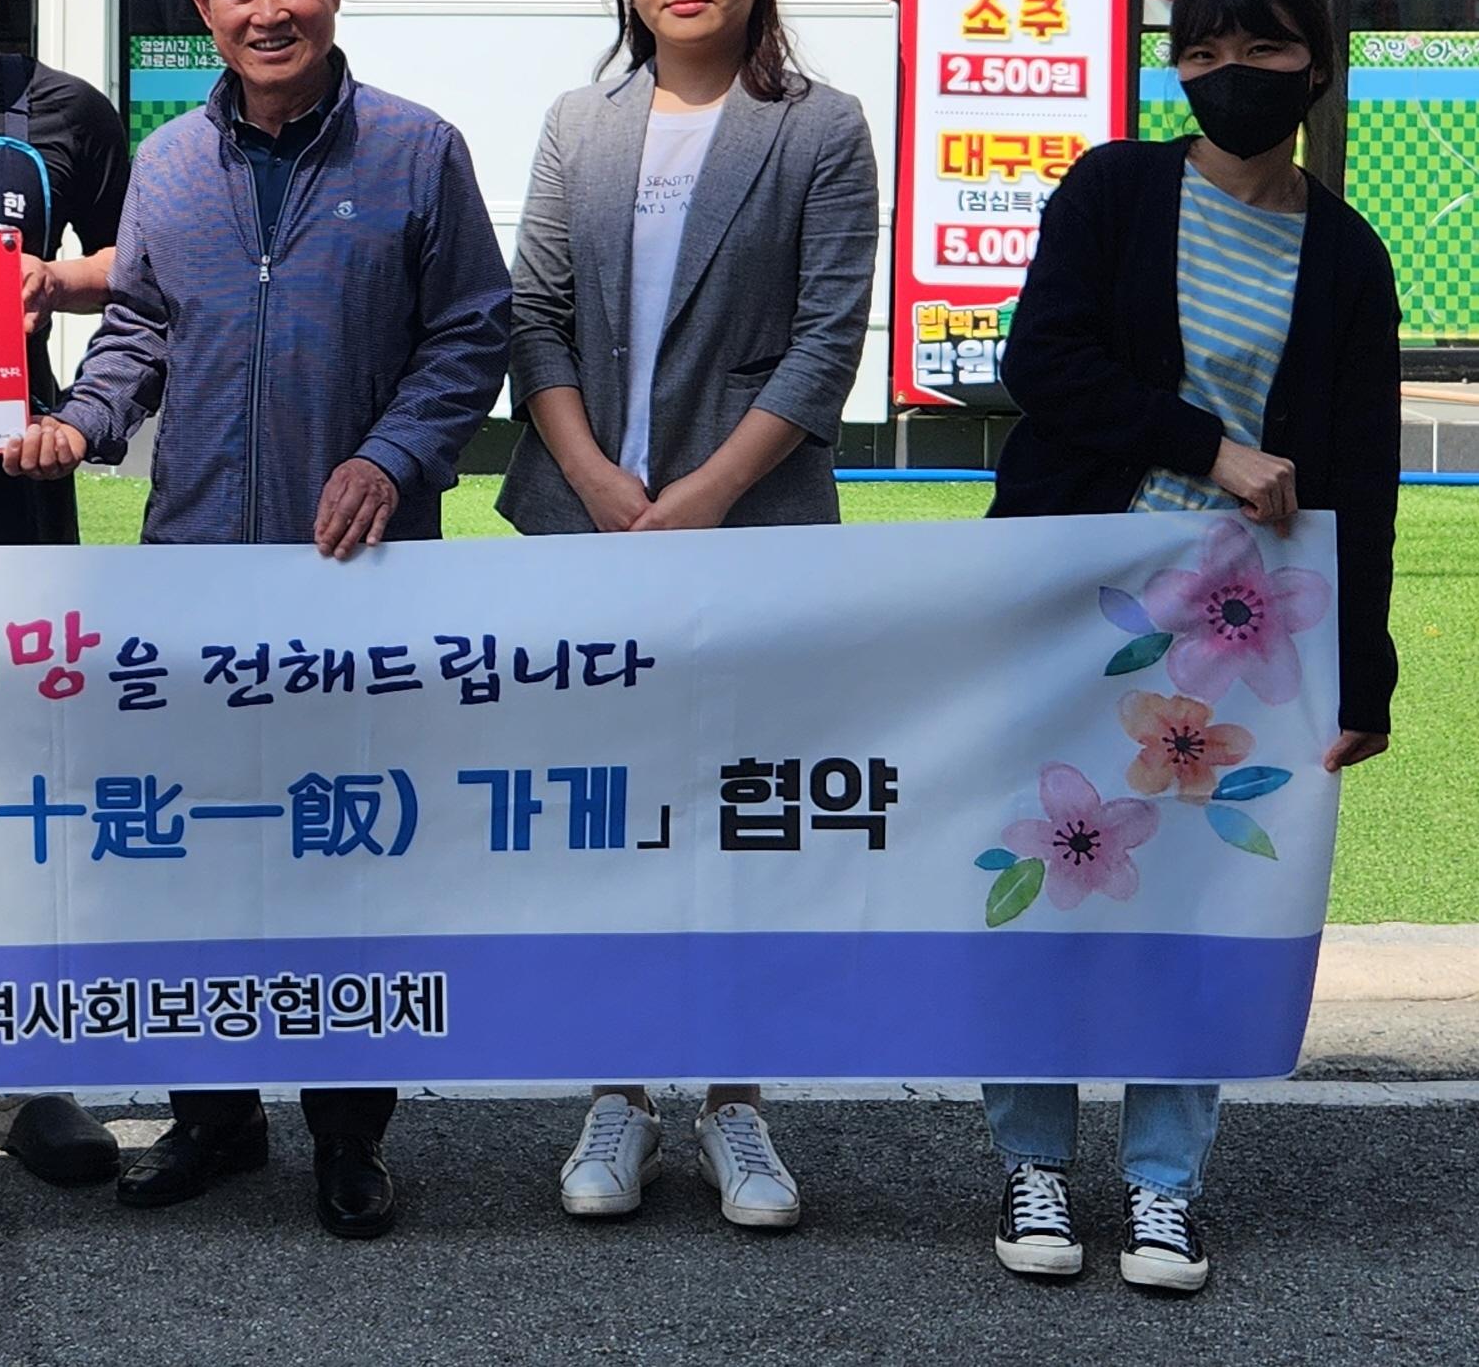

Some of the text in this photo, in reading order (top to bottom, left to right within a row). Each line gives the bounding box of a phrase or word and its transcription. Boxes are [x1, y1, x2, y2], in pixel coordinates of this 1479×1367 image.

[140, 54, 189, 67] 재료준비
[946, 56, 1081, 94] 2.500원
[916, 339, 1007, 386] 만원
[201, 634, 656, 708] 전해드립니다
[718, 757, 899, 852] 협약
